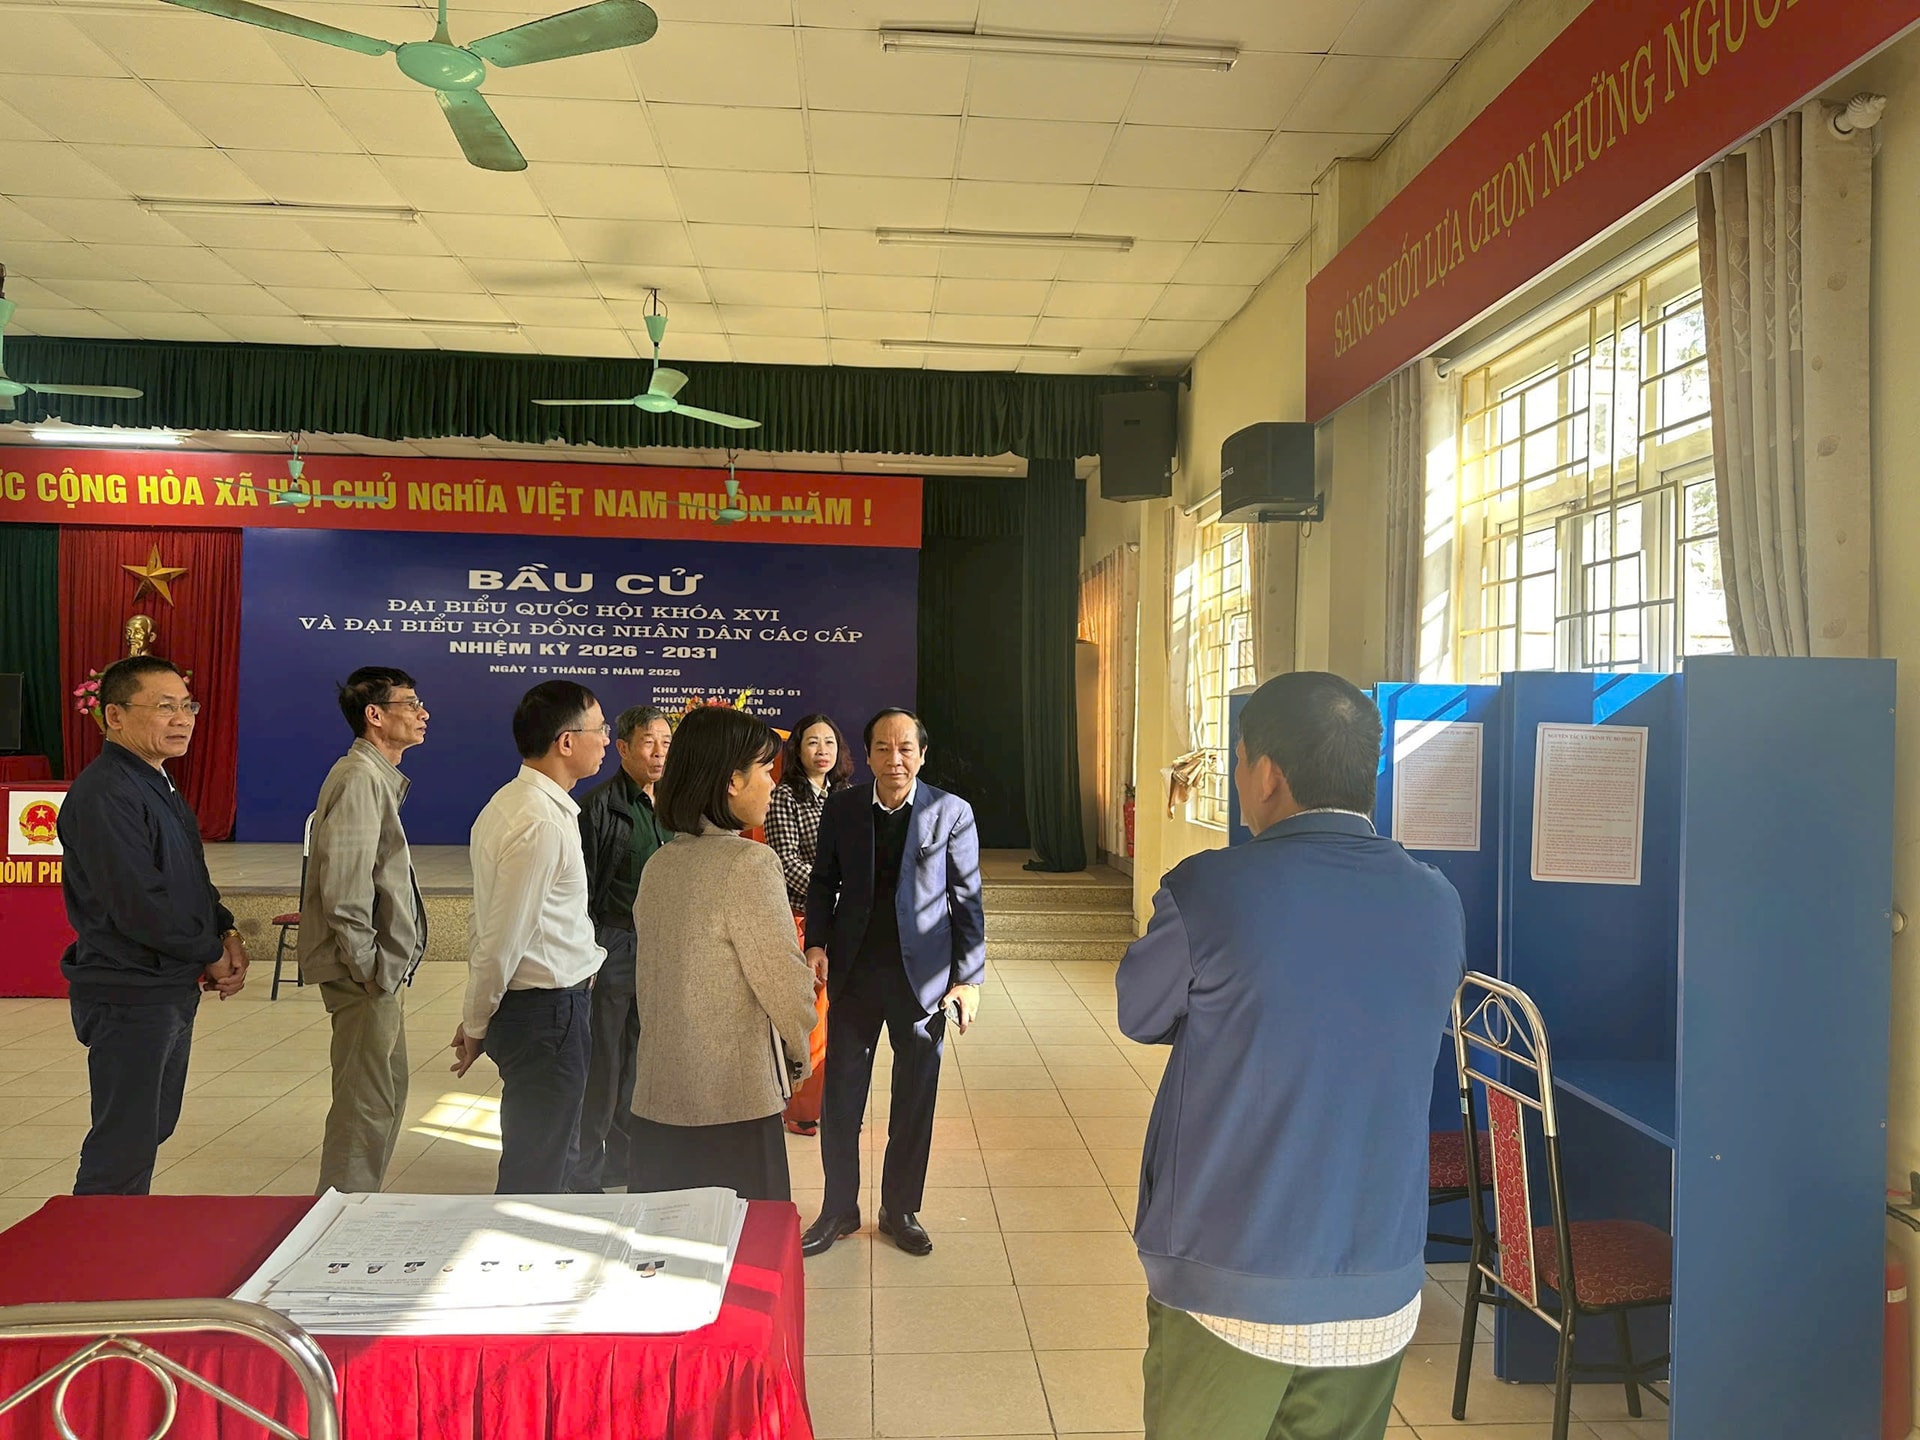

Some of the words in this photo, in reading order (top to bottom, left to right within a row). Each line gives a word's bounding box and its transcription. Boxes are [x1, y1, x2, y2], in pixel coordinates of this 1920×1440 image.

[1334, 283, 1375, 359] SÁNG
[1377, 232, 1422, 325] SUỐT
[1425, 207, 1465, 288] LỰA
[1468, 142, 1536, 253] CHỌN
[1541, 40, 1655, 199] NHỮNG
[0, 468, 26, 501] C
[36, 467, 127, 509] CỘNG
[137, 468, 205, 506] HÒA
[214, 472, 259, 507] XÃ
[333, 471, 397, 510] CHỦ
[408, 478, 507, 513] NGHĨA
[516, 481, 584, 521] VIỆT
[594, 488, 667, 520] NAM
[782, 491, 852, 526] NĂM
[863, 498, 872, 526] !
[468, 563, 594, 593] BẦU
[615, 567, 704, 597] CỬ
[387, 599, 436, 615] ĐẠI
[444, 594, 508, 614] BIỂU
[515, 598, 588, 617] QUỐC
[596, 602, 643, 621] HỘI
[652, 603, 725, 621] KHÓA
[733, 608, 780, 622] XVI
[299, 614, 336, 631] VÀ
[344, 617, 393, 635] ĐẠI
[401, 613, 464, 634] BIỂU
[472, 619, 521, 638] HỘI
[529, 618, 606, 638] ĐỒNG
[613, 622, 689, 639] NHÂN
[697, 623, 753, 641] DÂN
[759, 625, 808, 642] CÁC
[814, 625, 863, 643] CẤP
[449, 640, 532, 656] NHIỆM
[539, 641, 571, 656] KỲ
[578, 644, 637, 657] 2026
[662, 646, 717, 660] 2031
[489, 664, 527, 673] NGÀY
[531, 666, 548, 674] 15
[551, 665, 597, 675] THÁNG
[600, 667, 609, 675] 3
[612, 666, 644, 676] NĂM
[648, 668, 681, 677] 2026
[652, 686, 678, 694] KHU
[681, 686, 705, 695] VỰC
[728, 686, 764, 696] PHẾU
[767, 687, 784, 696] SỐ
[757, 707, 782, 717] NỘI
